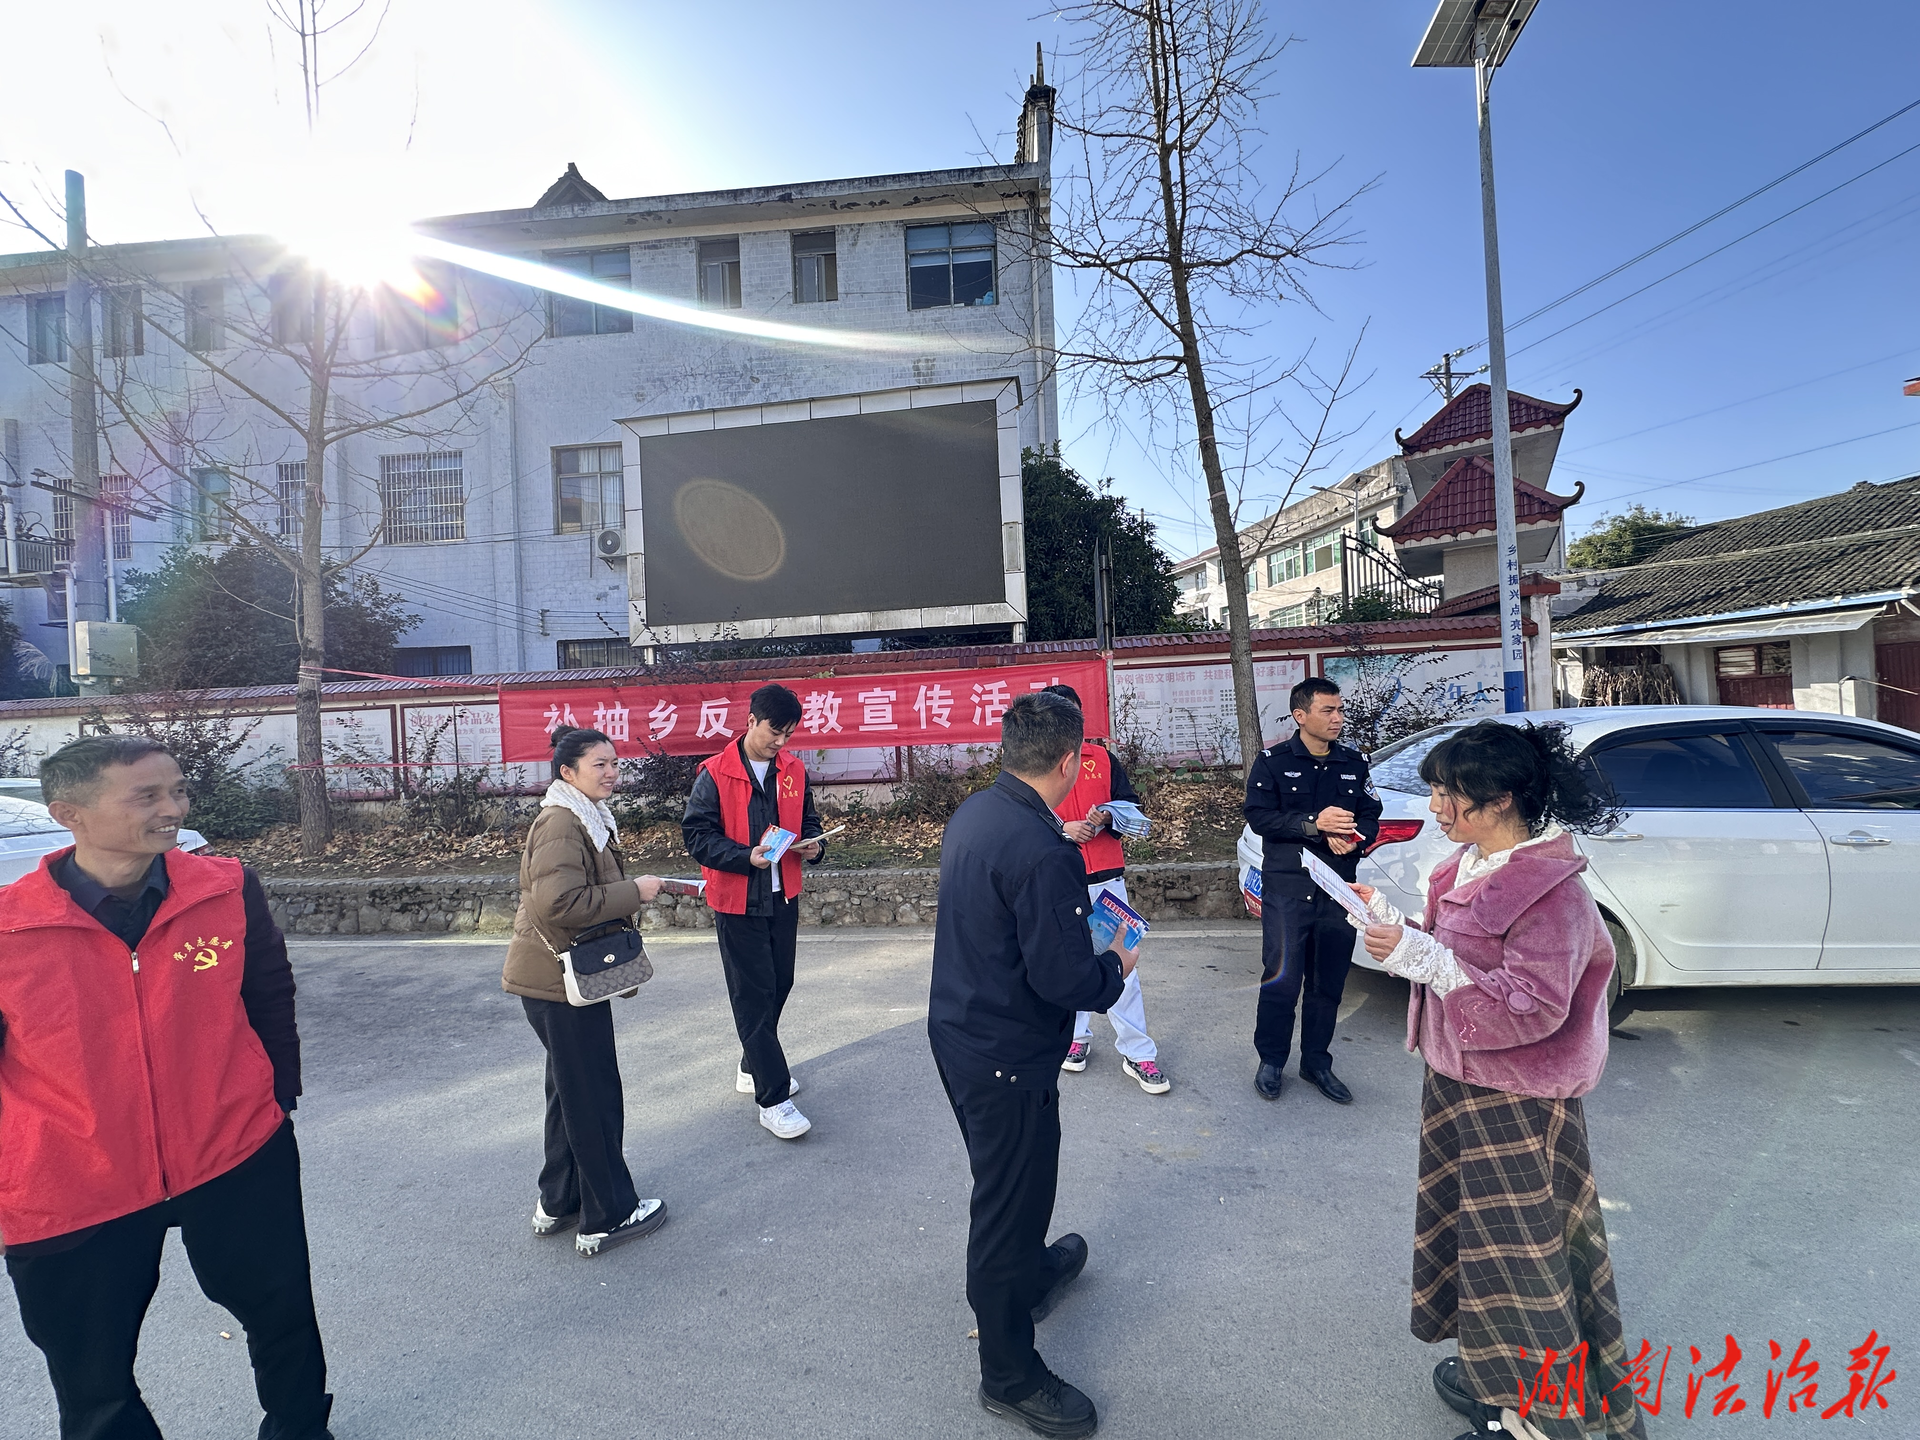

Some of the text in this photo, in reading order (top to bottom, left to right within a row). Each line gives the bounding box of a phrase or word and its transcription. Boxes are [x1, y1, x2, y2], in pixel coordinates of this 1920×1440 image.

[1506, 544, 1523, 661] 乡村振兴点亮家园
[1203, 665, 1287, 681] 共建和好家园
[543, 677, 1060, 742] 补抽乡反教宣传活
[173, 936, 234, 961] 党员志愿者
